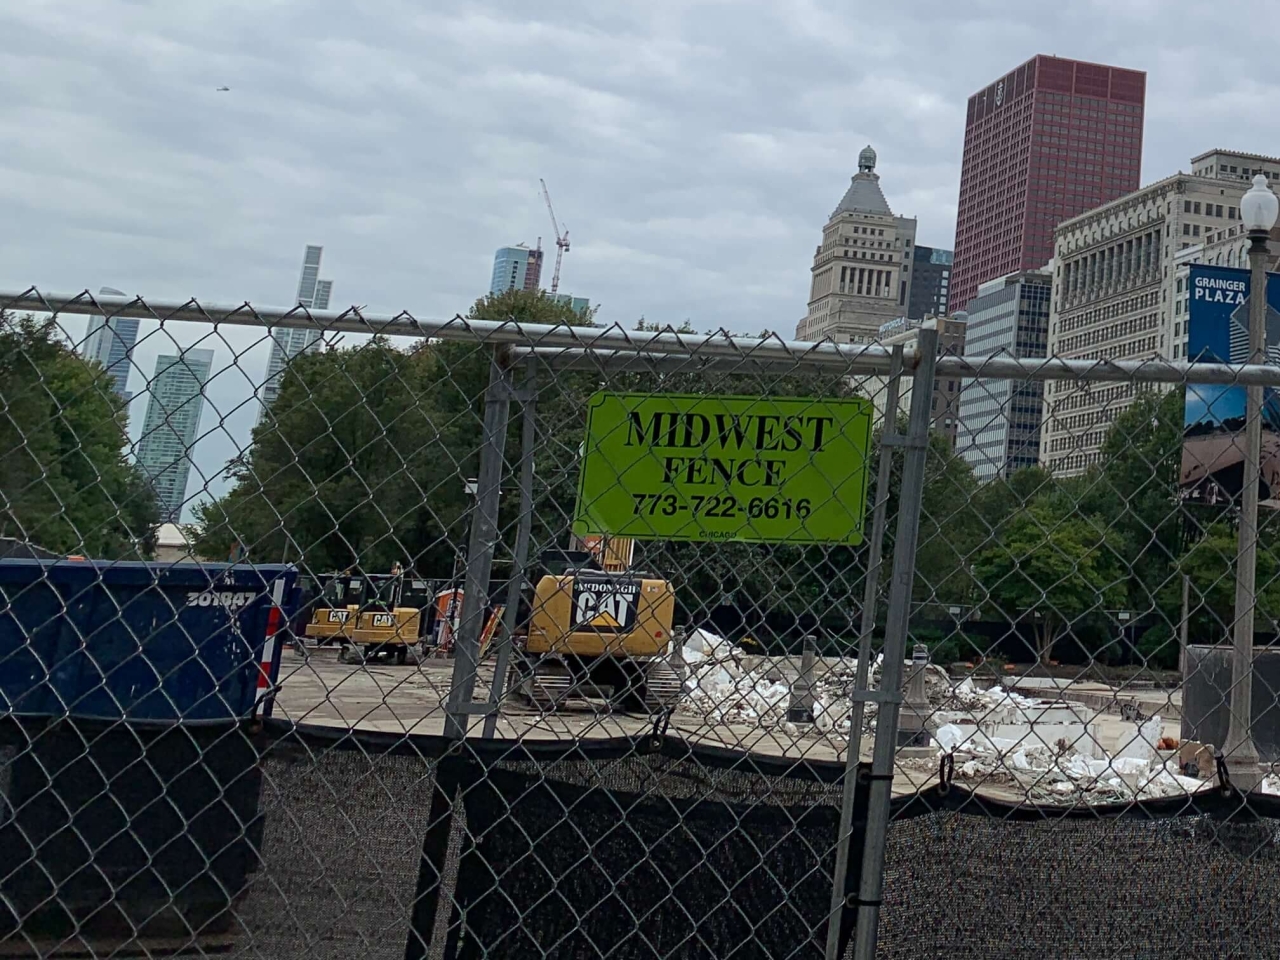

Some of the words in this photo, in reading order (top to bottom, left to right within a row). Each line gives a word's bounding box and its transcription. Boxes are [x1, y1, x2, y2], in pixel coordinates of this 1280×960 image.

[1194, 276, 1246, 291] GRAINGER
[1194, 287, 1246, 305] PLAZA
[623, 411, 834, 453] MIDWEST
[661, 456, 787, 488] FENCE
[631, 493, 812, 520] 773-722-6616
[187, 592, 257, 607] 301847
[329, 611, 349, 623] CAT
[575, 591, 634, 627] CAT
[373, 614, 396, 627] CAT
